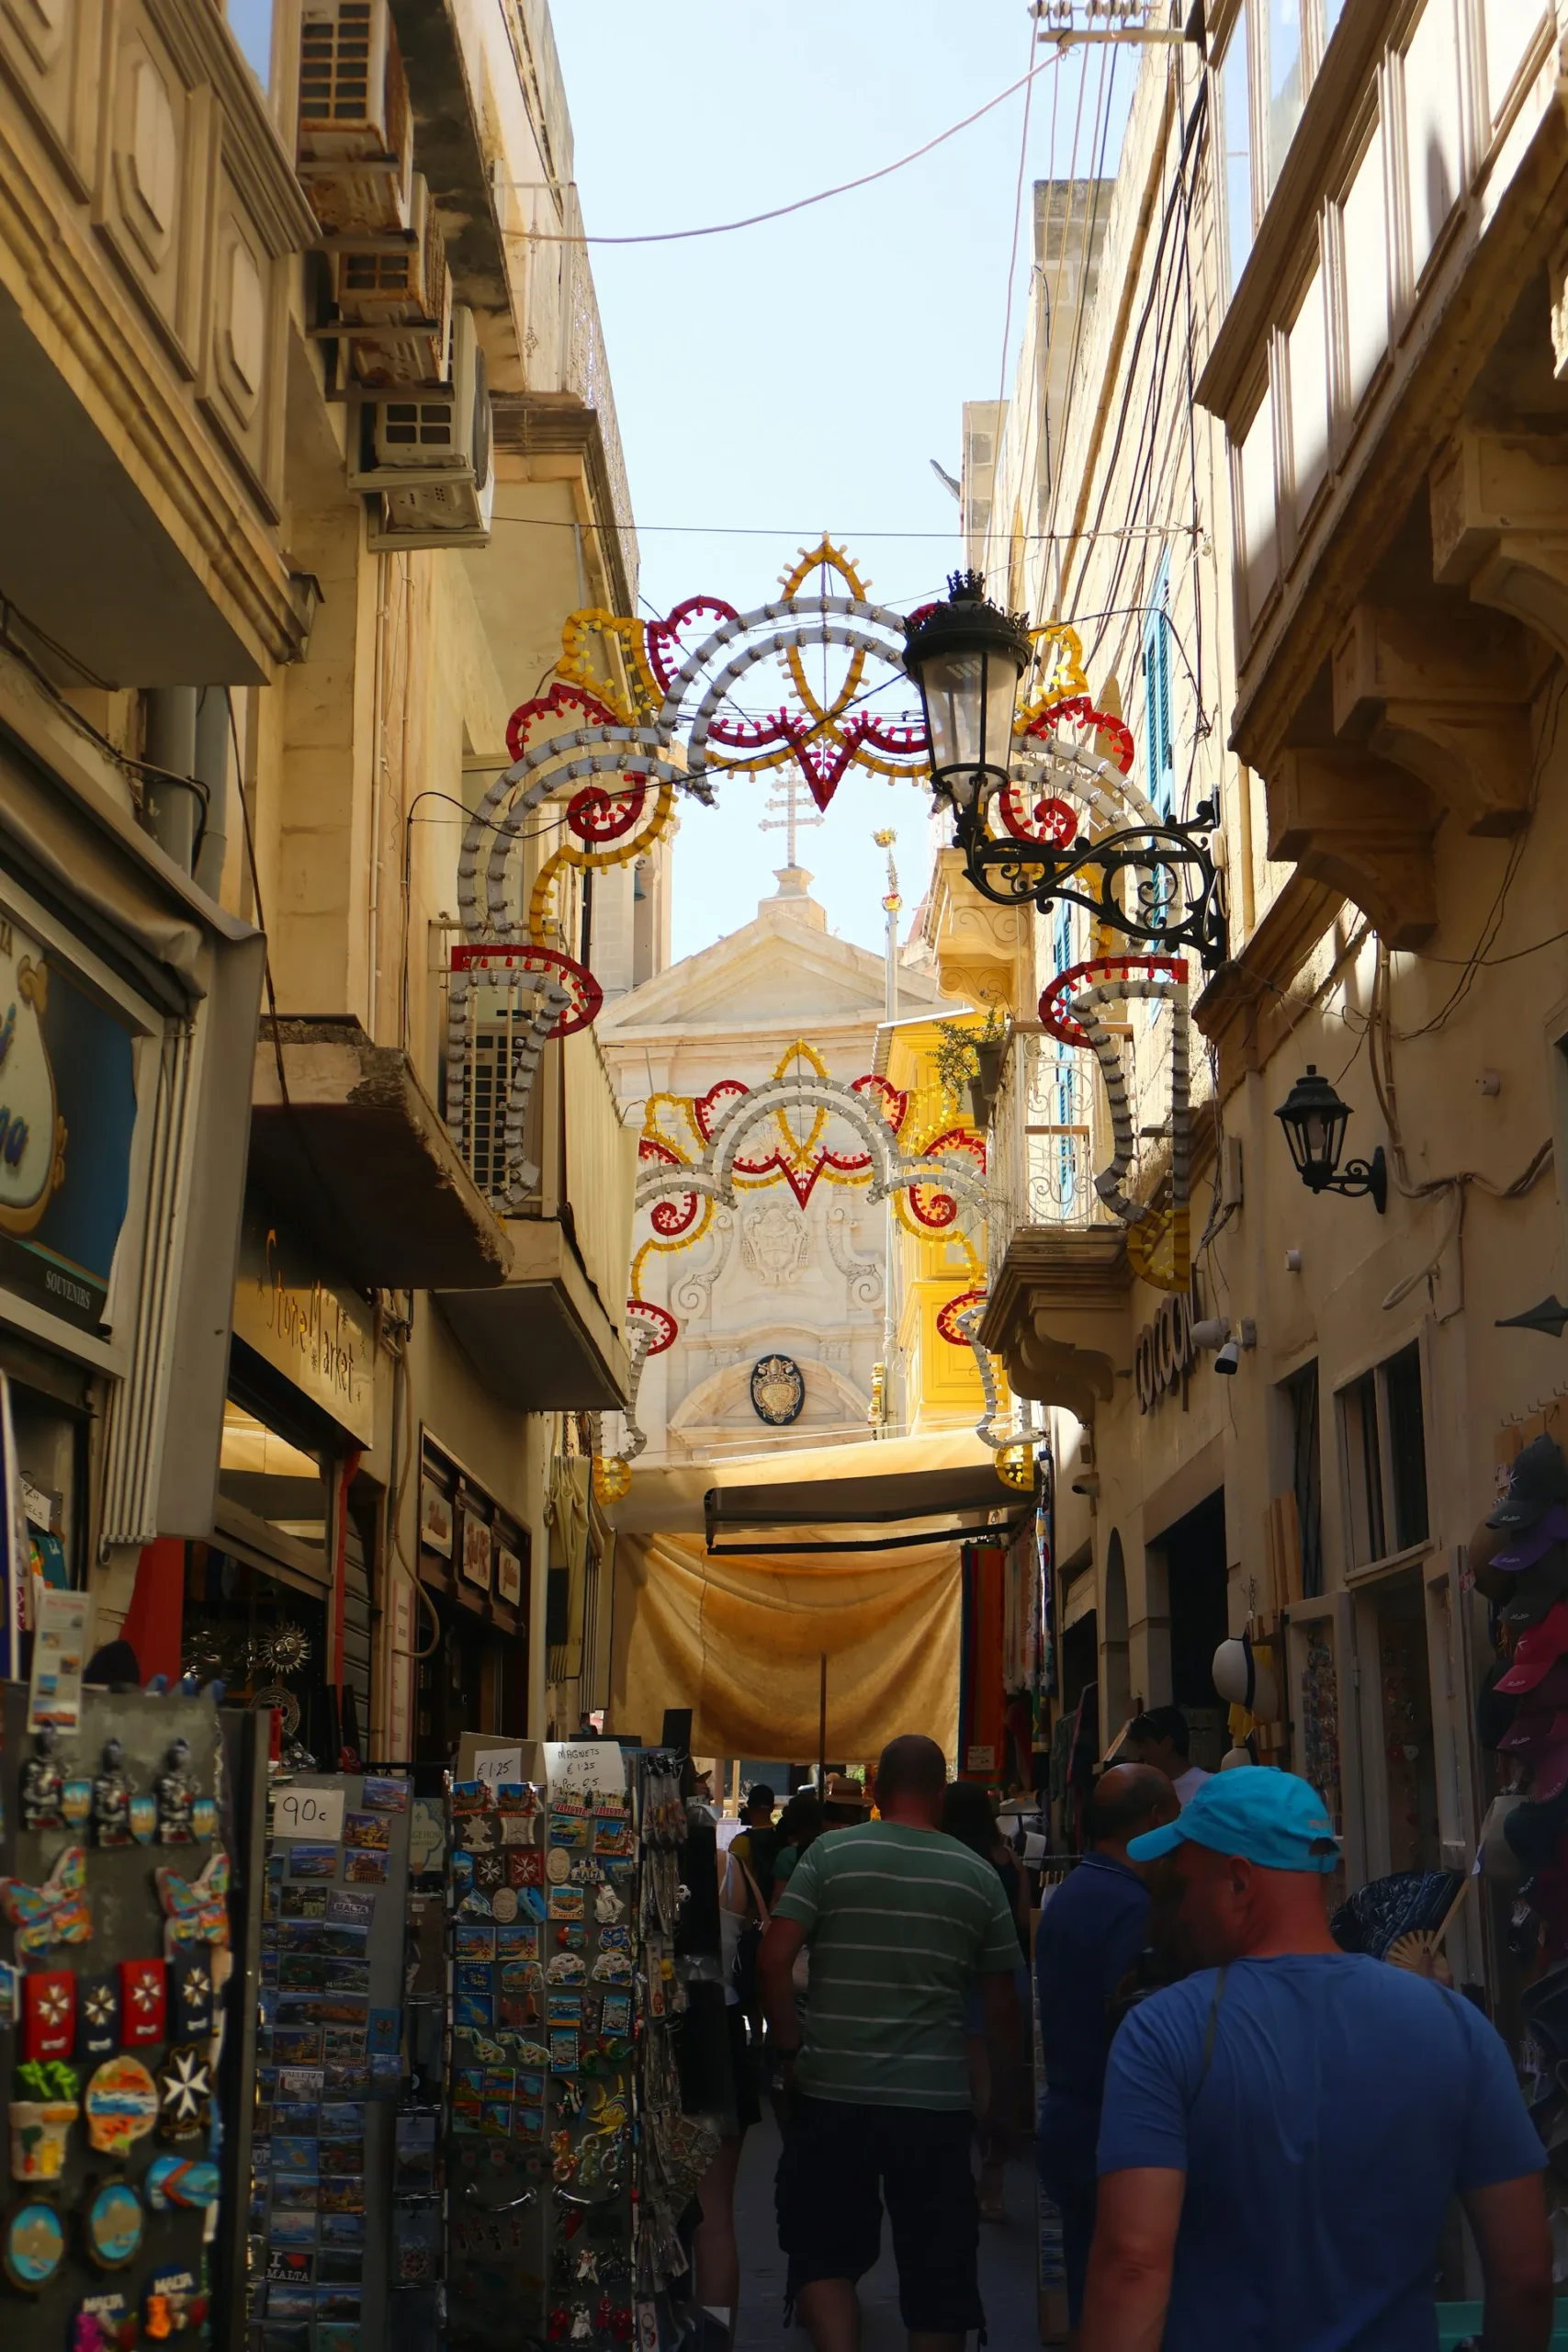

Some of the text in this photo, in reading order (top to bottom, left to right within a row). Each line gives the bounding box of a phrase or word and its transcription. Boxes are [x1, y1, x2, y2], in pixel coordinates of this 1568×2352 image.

[45, 1270, 91, 1310] SOUVENIRS
[1509, 1612, 1531, 1621] Malta
[558, 1748, 600, 1760] MAGNETS
[283, 1796, 327, 1826] 90c
[556, 1803, 587, 1816] VALLETTA
[594, 1805, 626, 1816] VALLETTA
[575, 1871, 601, 1880] MALTA
[335, 1902, 367, 1913] MALTA
[280, 2071, 323, 2079] VALLETTA
[269, 2251, 283, 2268] I
[265, 2268, 310, 2282] MALTA
